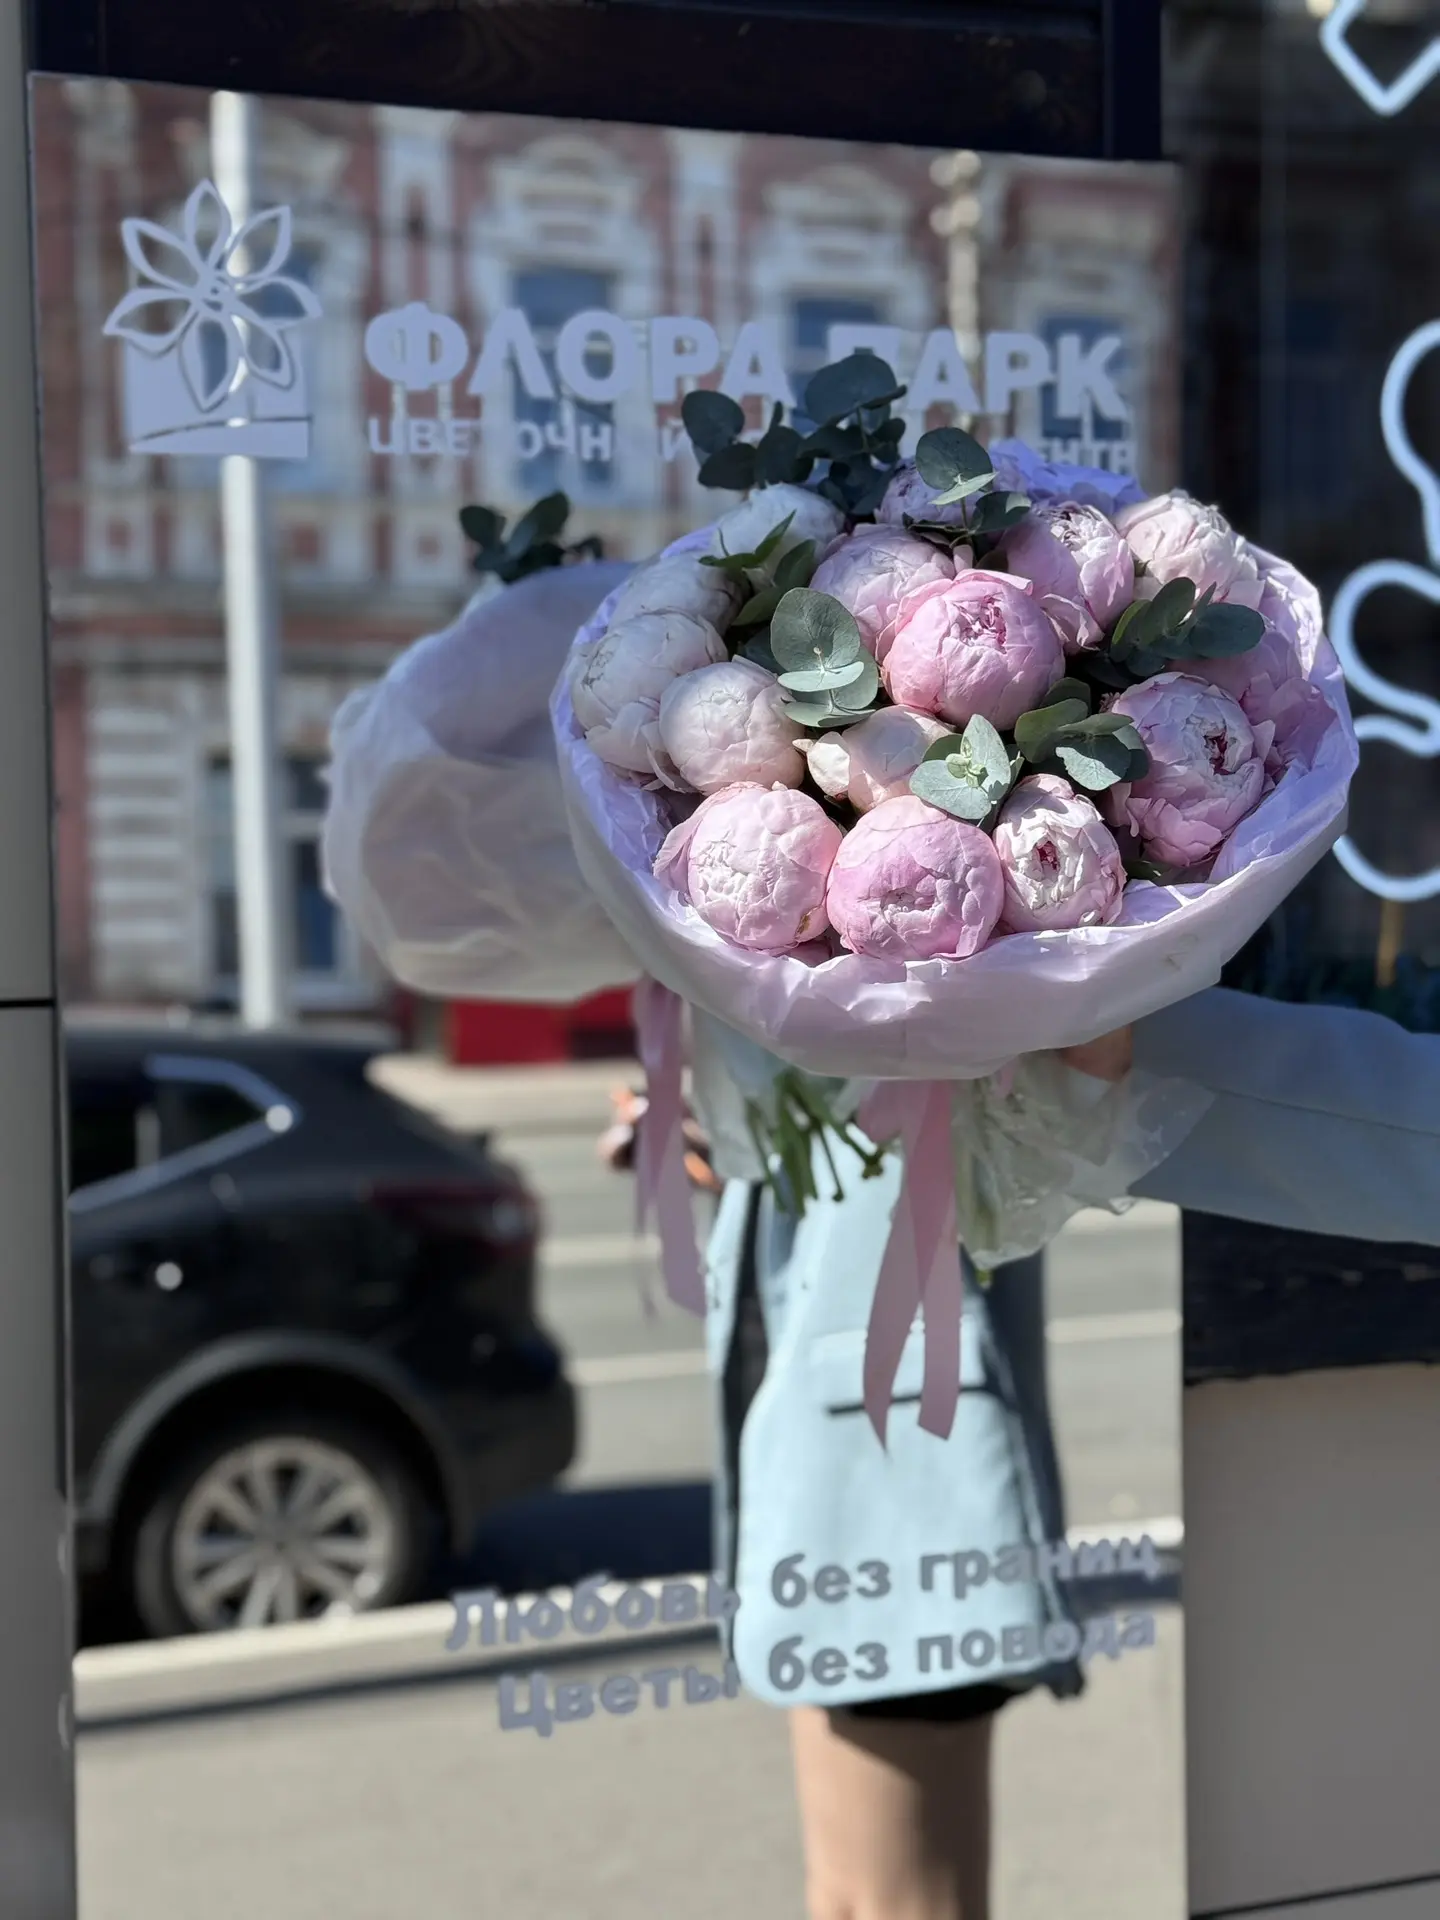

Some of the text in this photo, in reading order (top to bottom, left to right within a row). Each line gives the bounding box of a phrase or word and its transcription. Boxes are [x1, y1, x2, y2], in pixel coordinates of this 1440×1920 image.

[365, 301, 798, 408] ФЛОРА
[445, 1534, 1161, 1650] Любовь без границ
[498, 1611, 1156, 1738] Цветы без повода
